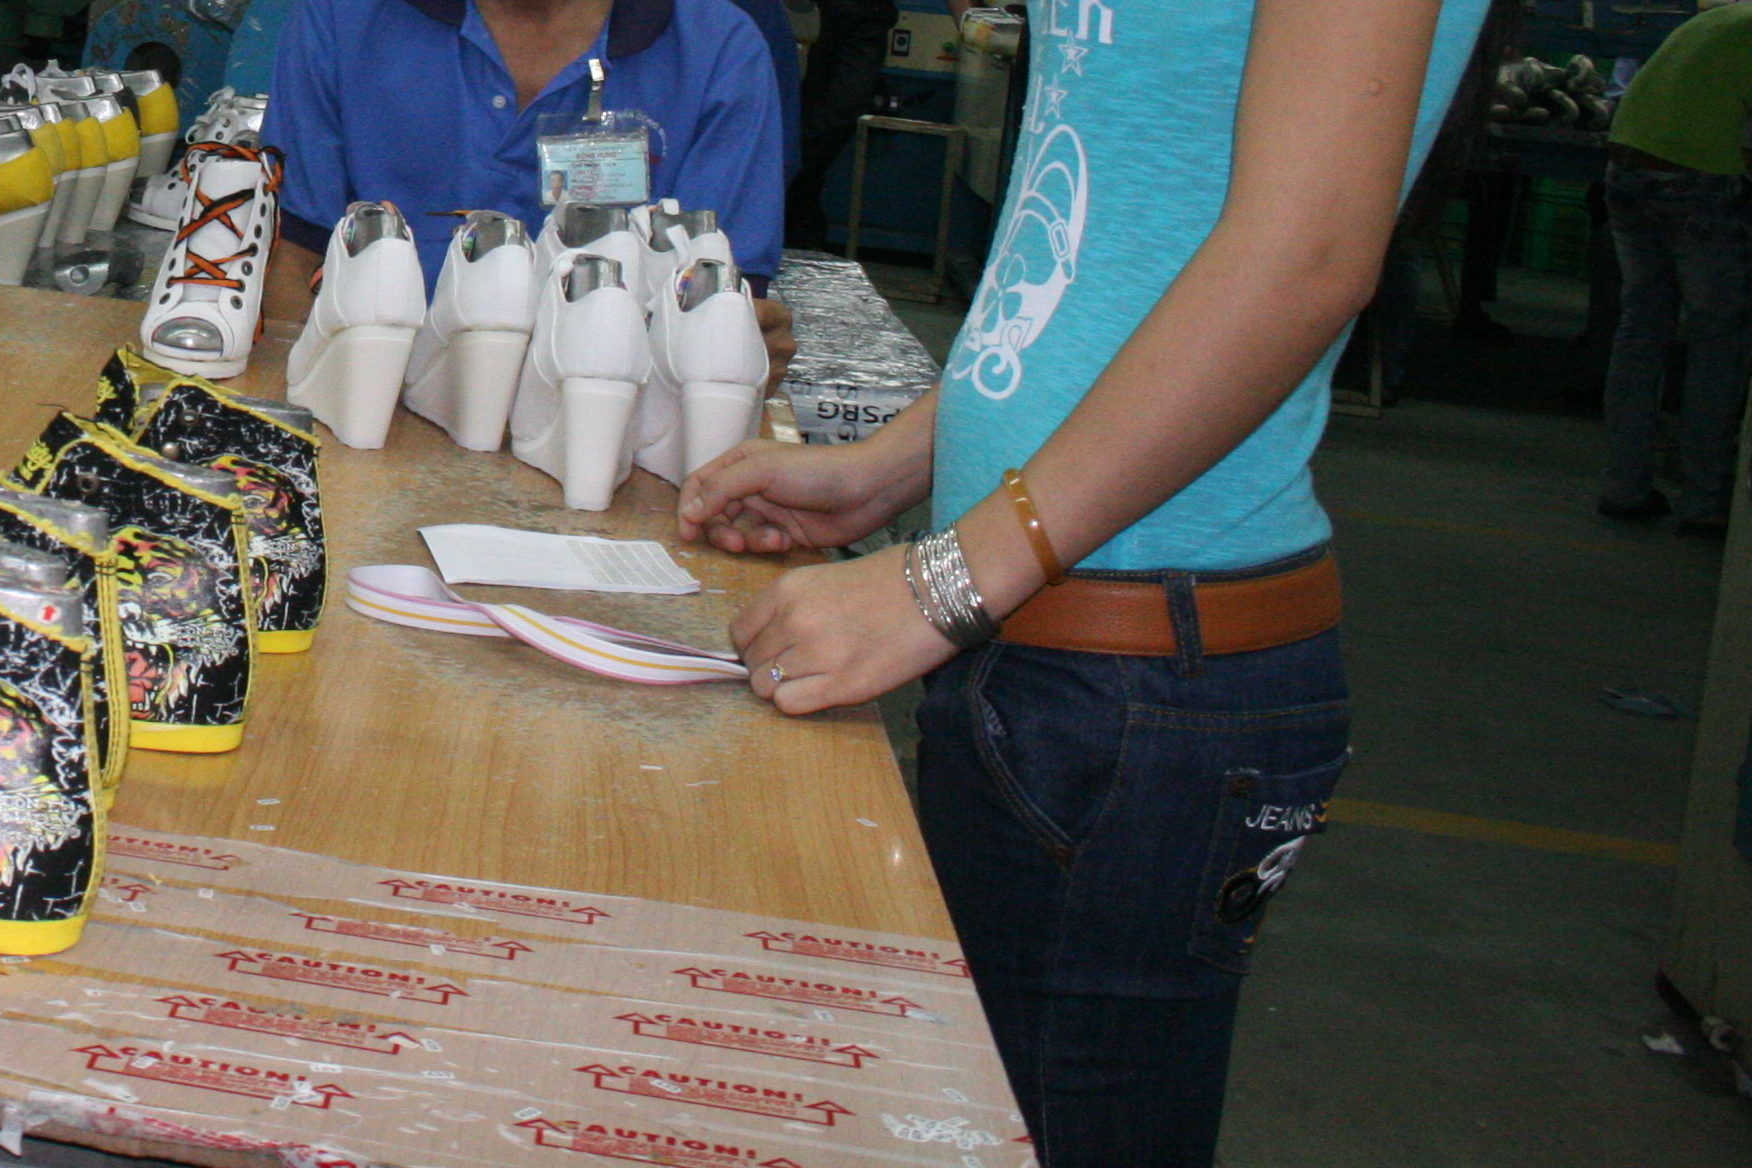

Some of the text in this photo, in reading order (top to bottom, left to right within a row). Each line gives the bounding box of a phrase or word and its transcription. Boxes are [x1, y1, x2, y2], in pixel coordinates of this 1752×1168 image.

[1245, 804, 1316, 831] JEANS
[415, 880, 570, 908] CAUTION!
[780, 932, 941, 960] CAUTION!
[257, 952, 426, 986] CAUTION!
[710, 968, 878, 999] CAUTION!
[119, 1046, 307, 1082] CAUTION!
[618, 1065, 804, 1103] CAUTION!
[563, 1119, 758, 1160] CAUTION!
